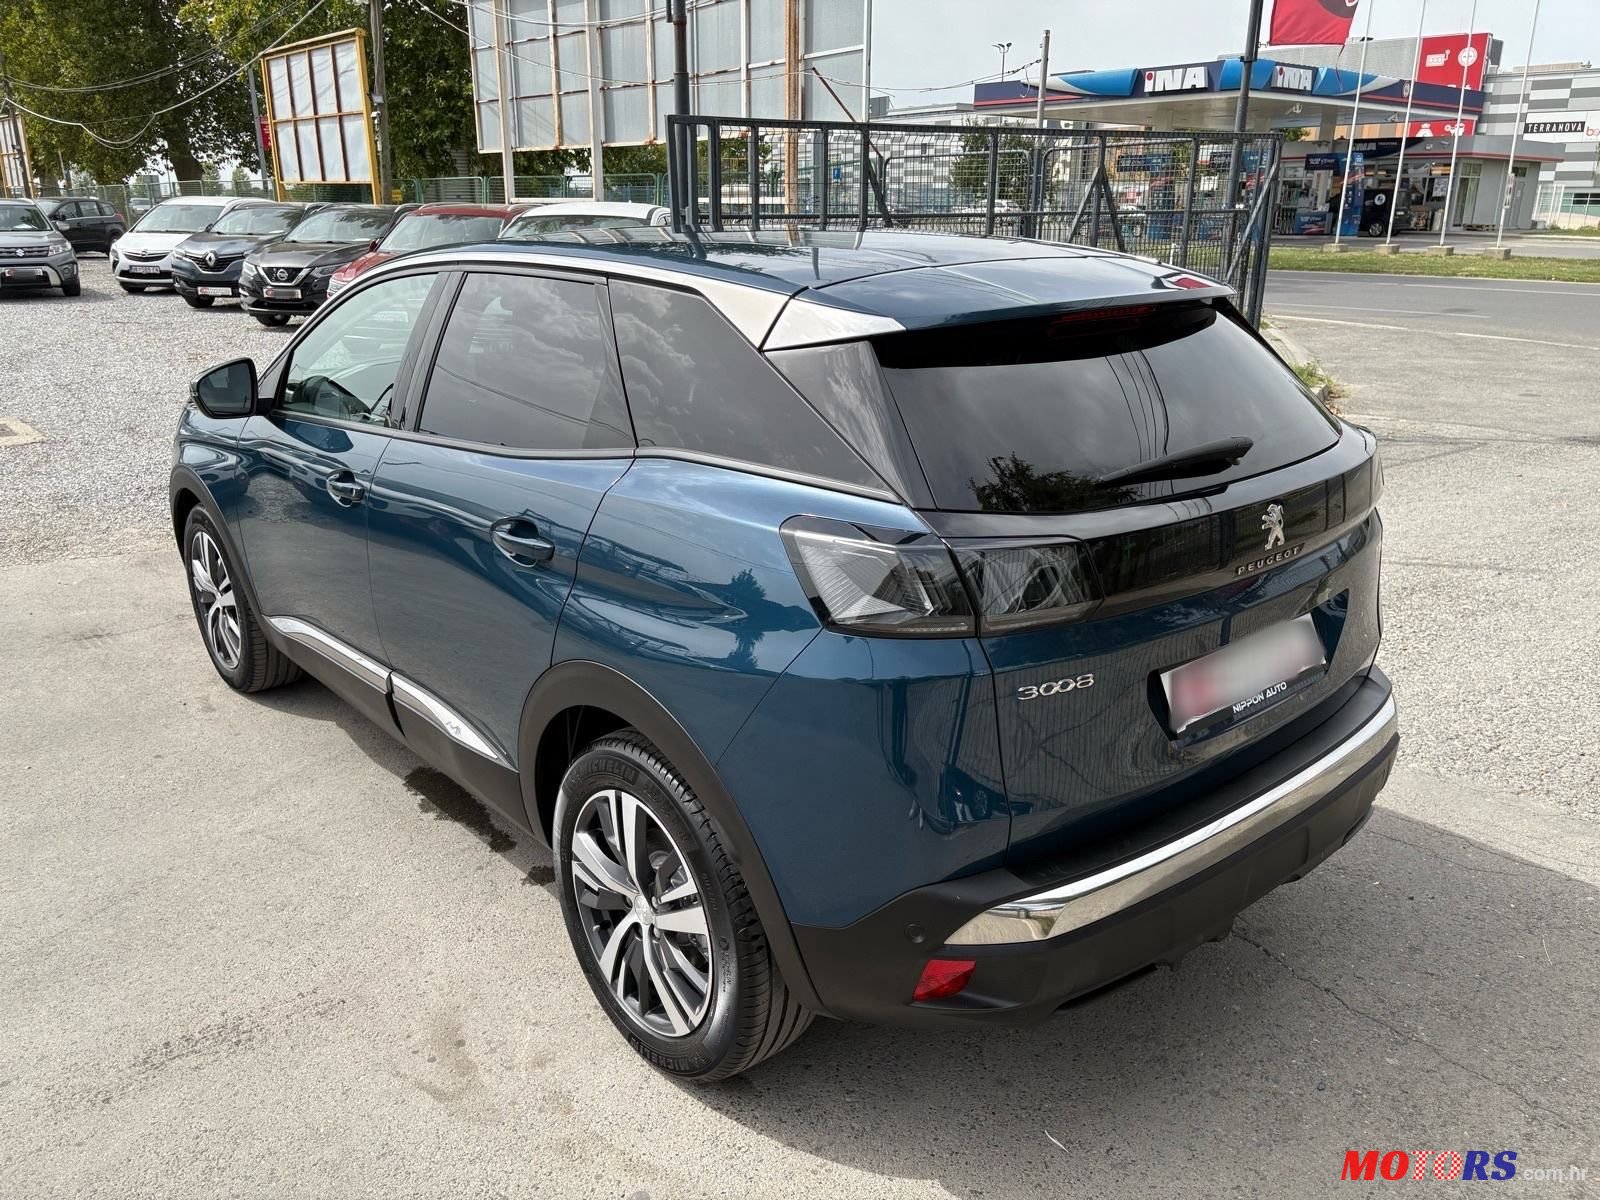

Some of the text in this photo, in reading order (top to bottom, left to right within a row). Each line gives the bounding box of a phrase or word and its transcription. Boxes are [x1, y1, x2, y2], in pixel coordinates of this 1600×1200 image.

[1527, 122, 1583, 133] TERRANOVA
[1237, 546, 1299, 575] PEUGEOT
[1017, 673, 1095, 701] 3008
[1232, 681, 1288, 714] NIPPON AUTO
